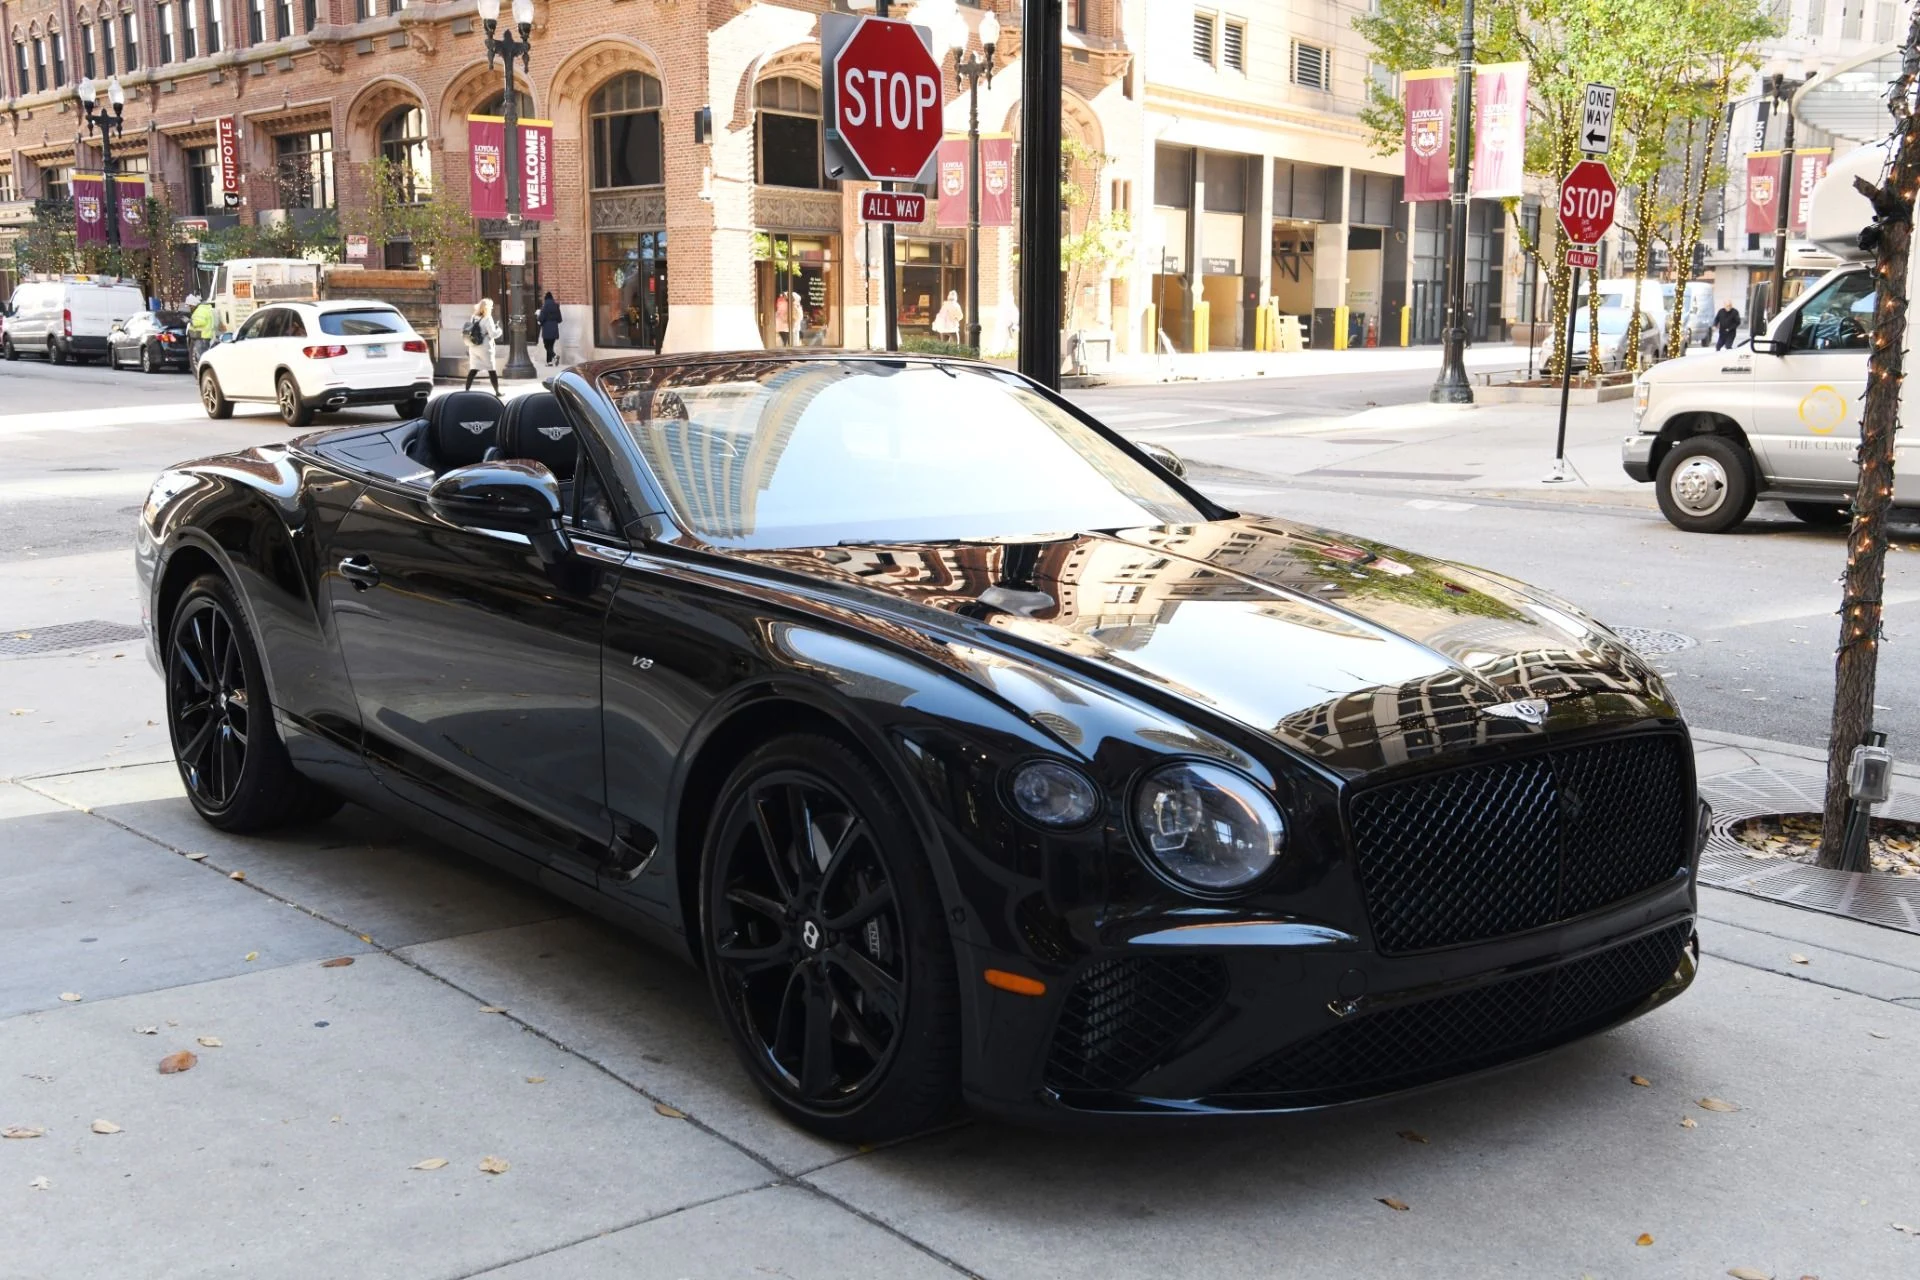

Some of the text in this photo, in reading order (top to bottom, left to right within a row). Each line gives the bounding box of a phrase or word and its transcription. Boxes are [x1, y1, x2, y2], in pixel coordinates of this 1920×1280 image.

[844, 67, 937, 130] STOP
[1589, 90, 1611, 108] ONE
[1412, 108, 1443, 118] LOYOLA
[1587, 108, 1610, 126] WAY
[222, 121, 236, 189] CHIPOTLE
[526, 129, 539, 209] WELCOME
[1798, 157, 1815, 224] WELCOME
[868, 198, 920, 218] ALL WAY
[1563, 186, 1613, 220] STOP
[1569, 253, 1595, 265] ALL WAY
[1787, 440, 1812, 451] THE
[632, 655, 654, 670] V8
